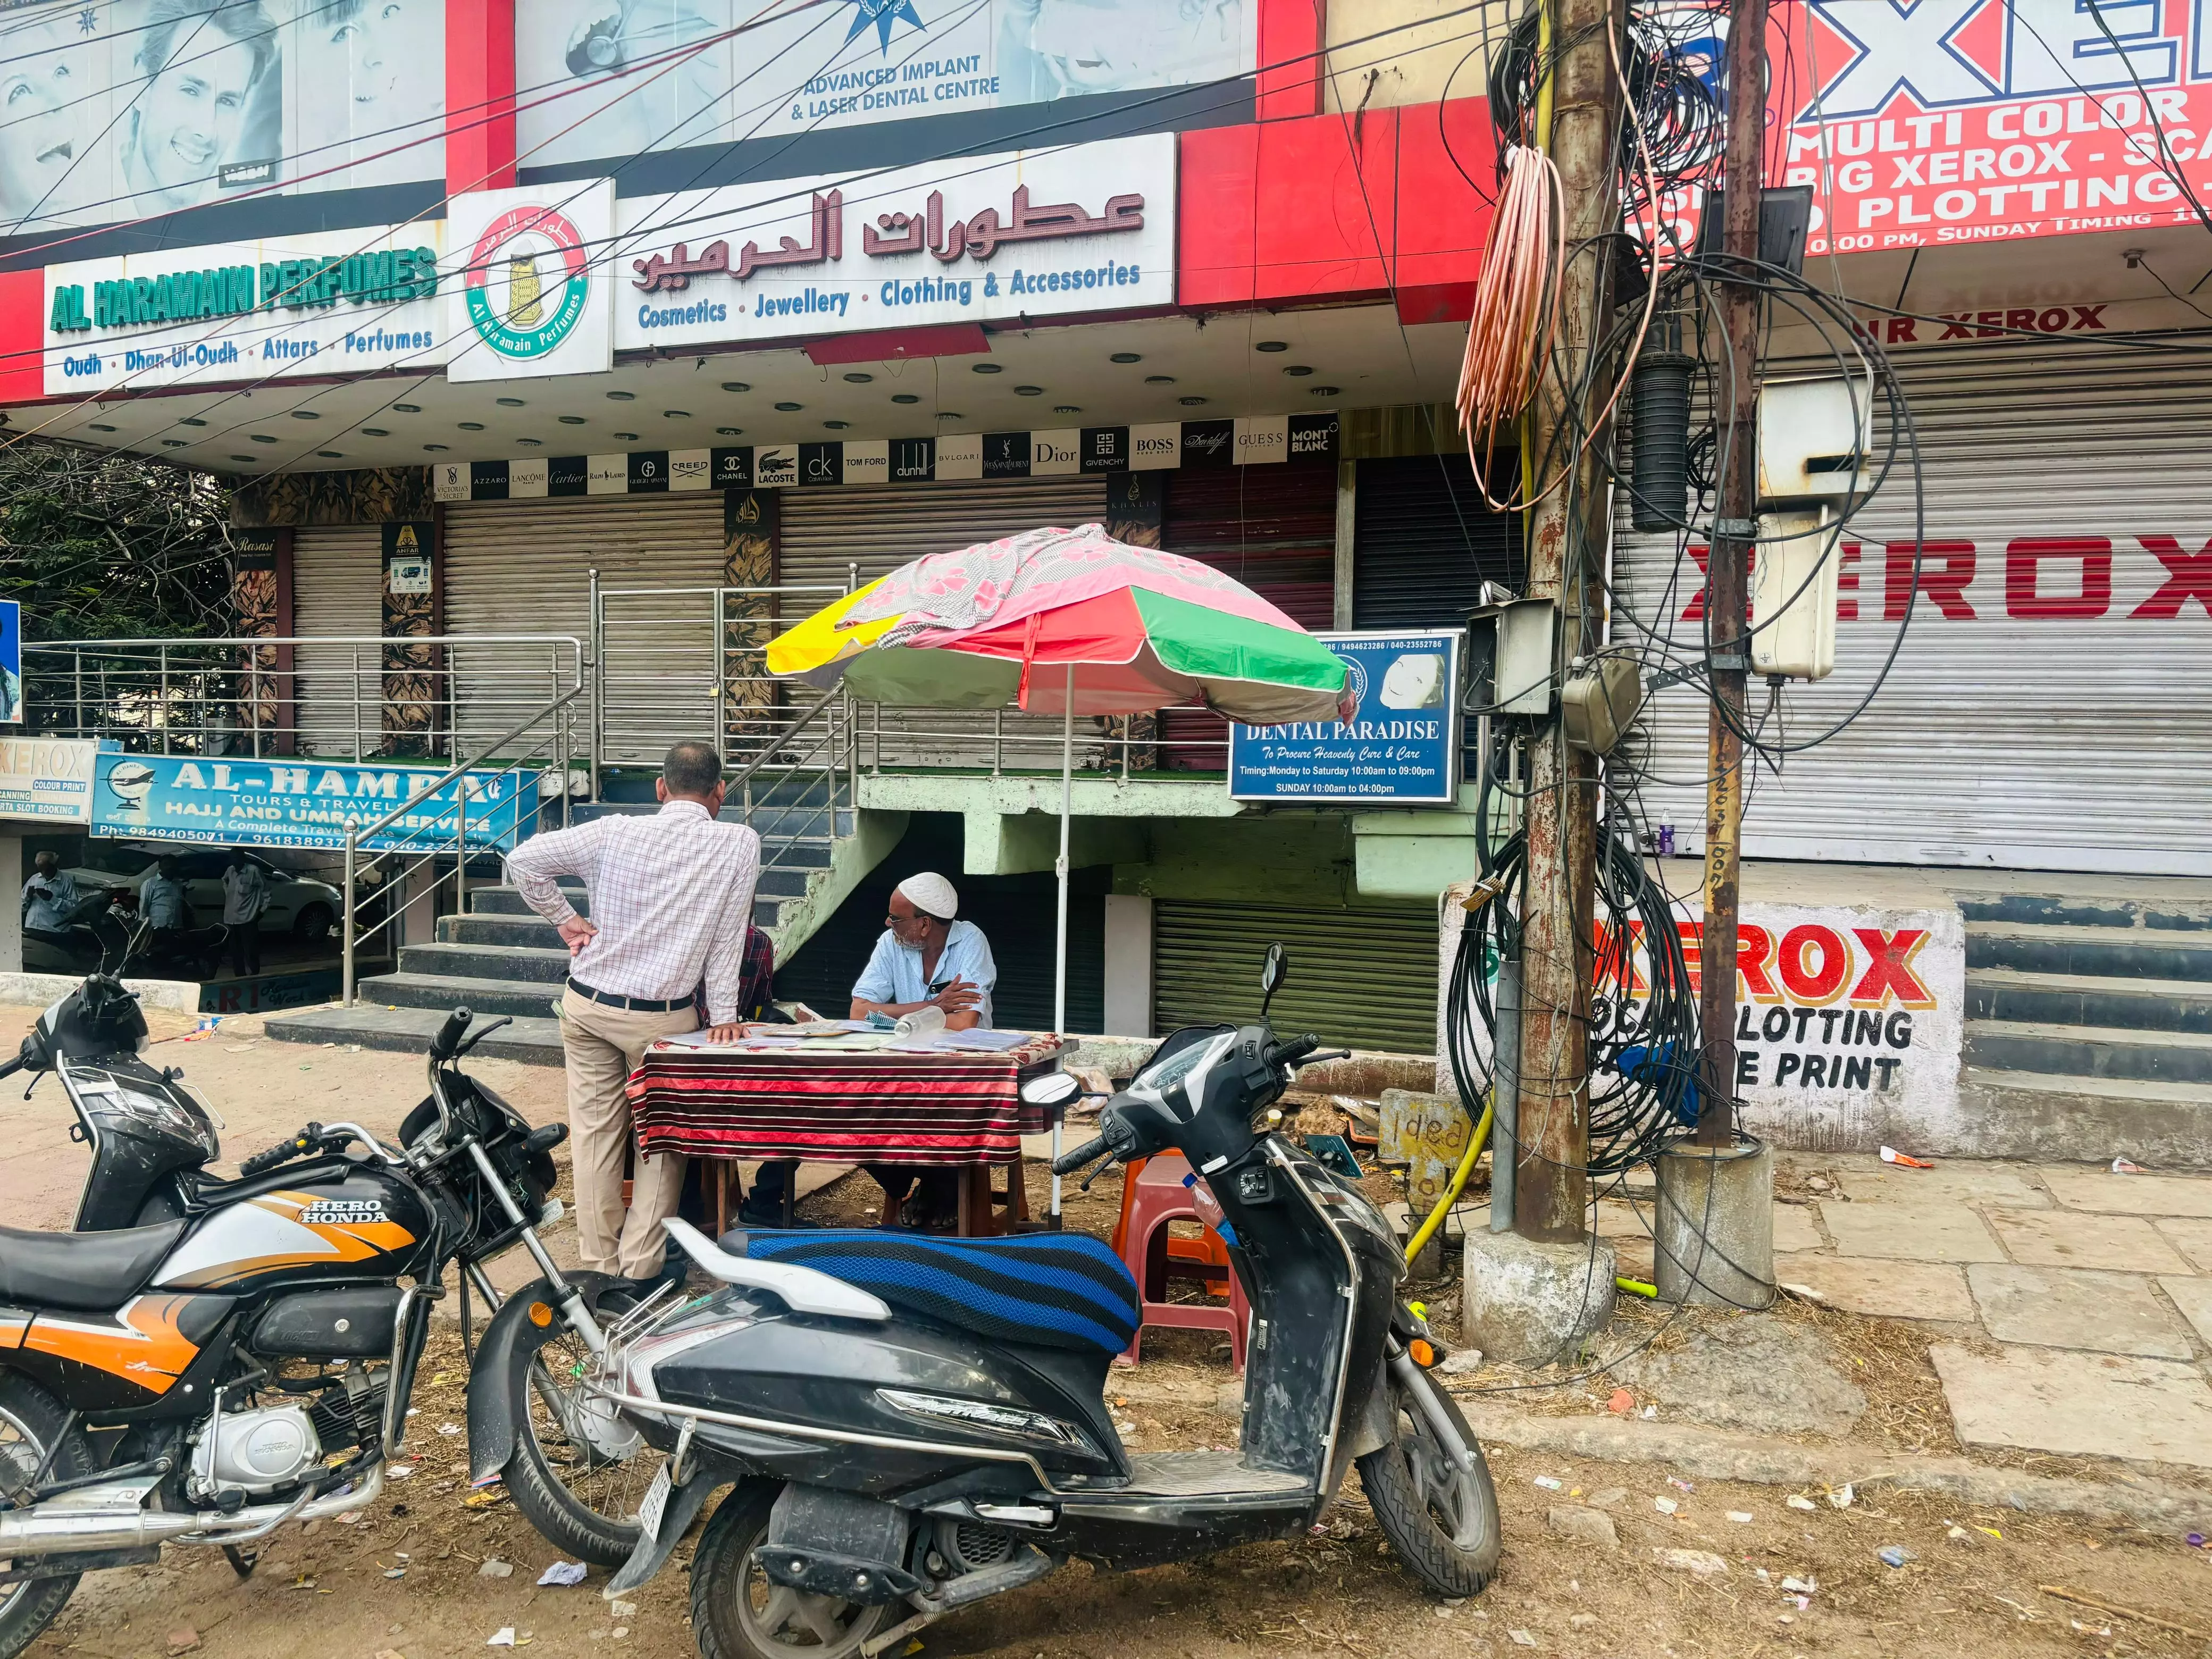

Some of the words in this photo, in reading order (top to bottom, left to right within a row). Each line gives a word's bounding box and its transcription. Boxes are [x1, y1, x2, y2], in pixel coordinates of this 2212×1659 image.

[1787, 0, 2212, 125] XE
[804, 68, 896, 96] ADVANCED
[902, 54, 981, 82] IMPLANT
[791, 104, 803, 121] &
[809, 95, 858, 118] LASER
[863, 87, 929, 112] DENTAL
[934, 77, 1000, 102] CENTRE
[1788, 113, 1962, 162] MULTI
[1988, 90, 2189, 140] COLOR
[1787, 161, 1873, 196] BIG
[1890, 140, 2072, 188] XEROX
[1858, 171, 2180, 229] PLOTTING
[863, 183, 1145, 262] عطورات
[632, 188, 843, 292] الحرمين
[1805, 234, 1874, 254] 0:00
[1936, 219, 2042, 242] SUNDAY
[2049, 213, 2152, 232] TIMING
[50, 283, 91, 333] AL
[93, 264, 255, 330] HARAMAIN
[259, 246, 438, 312] PERFUMES
[638, 298, 727, 330] Cosmetics
[754, 288, 850, 319] Jewellery
[881, 275, 972, 306] Clothing
[983, 272, 999, 298] &
[1009, 259, 1141, 297] Accessories
[472, 303, 485, 319] Al
[481, 320, 531, 351] Haramain
[538, 293, 580, 347] Perfumes
[1937, 304, 2108, 341] XEROX
[63, 355, 102, 377] Oudh
[124, 345, 239, 371] Dhan-Ul-Oudh
[263, 336, 319, 362] Attars
[345, 328, 433, 354] Perfumes
[1185, 431, 1230, 454] Davidoff
[1238, 432, 1283, 446] GUESS
[1292, 429, 1329, 441] MONT
[1034, 443, 1077, 463] Dior
[1136, 438, 1174, 452] BOSS
[1292, 440, 1329, 453] BLANC
[672, 461, 708, 471] CREED
[865, 457, 886, 466] FORD
[897, 442, 927, 476] dunhill
[1086, 458, 1125, 466] GIVENCHY
[474, 476, 507, 485] AZZARO
[549, 470, 586, 484] Cartier
[717, 472, 748, 481] CHANEL
[758, 474, 795, 484] LACOSTE
[437, 485, 468, 493] VICTORIA'S
[237, 537, 275, 551] Rasasi
[1342, 642, 1385, 650] 9494623286
[1390, 640, 1442, 650] 040-23552786
[1246, 720, 1329, 741] DENTAL
[1334, 720, 1439, 741] PARADISE
[1262, 747, 1275, 759] To
[1277, 746, 1312, 760] Procure
[1313, 746, 1356, 763] Heavenly
[1359, 747, 1382, 761] Cure
[1385, 746, 1393, 759] &
[1396, 747, 1420, 761] Care
[1302, 767, 1311, 776] to
[1312, 766, 1349, 777] Saturday
[1351, 766, 1386, 776] 10:00am
[1388, 767, 1397, 776] to
[1398, 766, 1435, 777] 09:00pm
[33, 780, 61, 790] COLOUR
[62, 782, 86, 792] PRINT
[171, 762, 489, 804] AL-HAMRA
[1276, 783, 1310, 793] SUNDAY
[1312, 783, 1347, 793] 10:00am
[1348, 784, 1357, 793] to
[1359, 784, 1395, 794] 04:00pm
[16, 803, 36, 812] SLOT
[38, 805, 73, 815] BOOKING
[229, 794, 292, 806] TOURS
[300, 798, 312, 807] &
[166, 802, 222, 818] HAJJ
[229, 806, 282, 820] AND
[289, 809, 382, 826] UMRAH
[214, 819, 224, 829] A
[228, 820, 298, 837] Complete
[252, 834, 349, 847] 961838937
[1737, 1006, 1912, 1049] LOTTING
[1775, 1053, 1901, 1092] PRINT
[310, 1200, 382, 1212] HERO
[300, 1212, 390, 1225] HONDA
